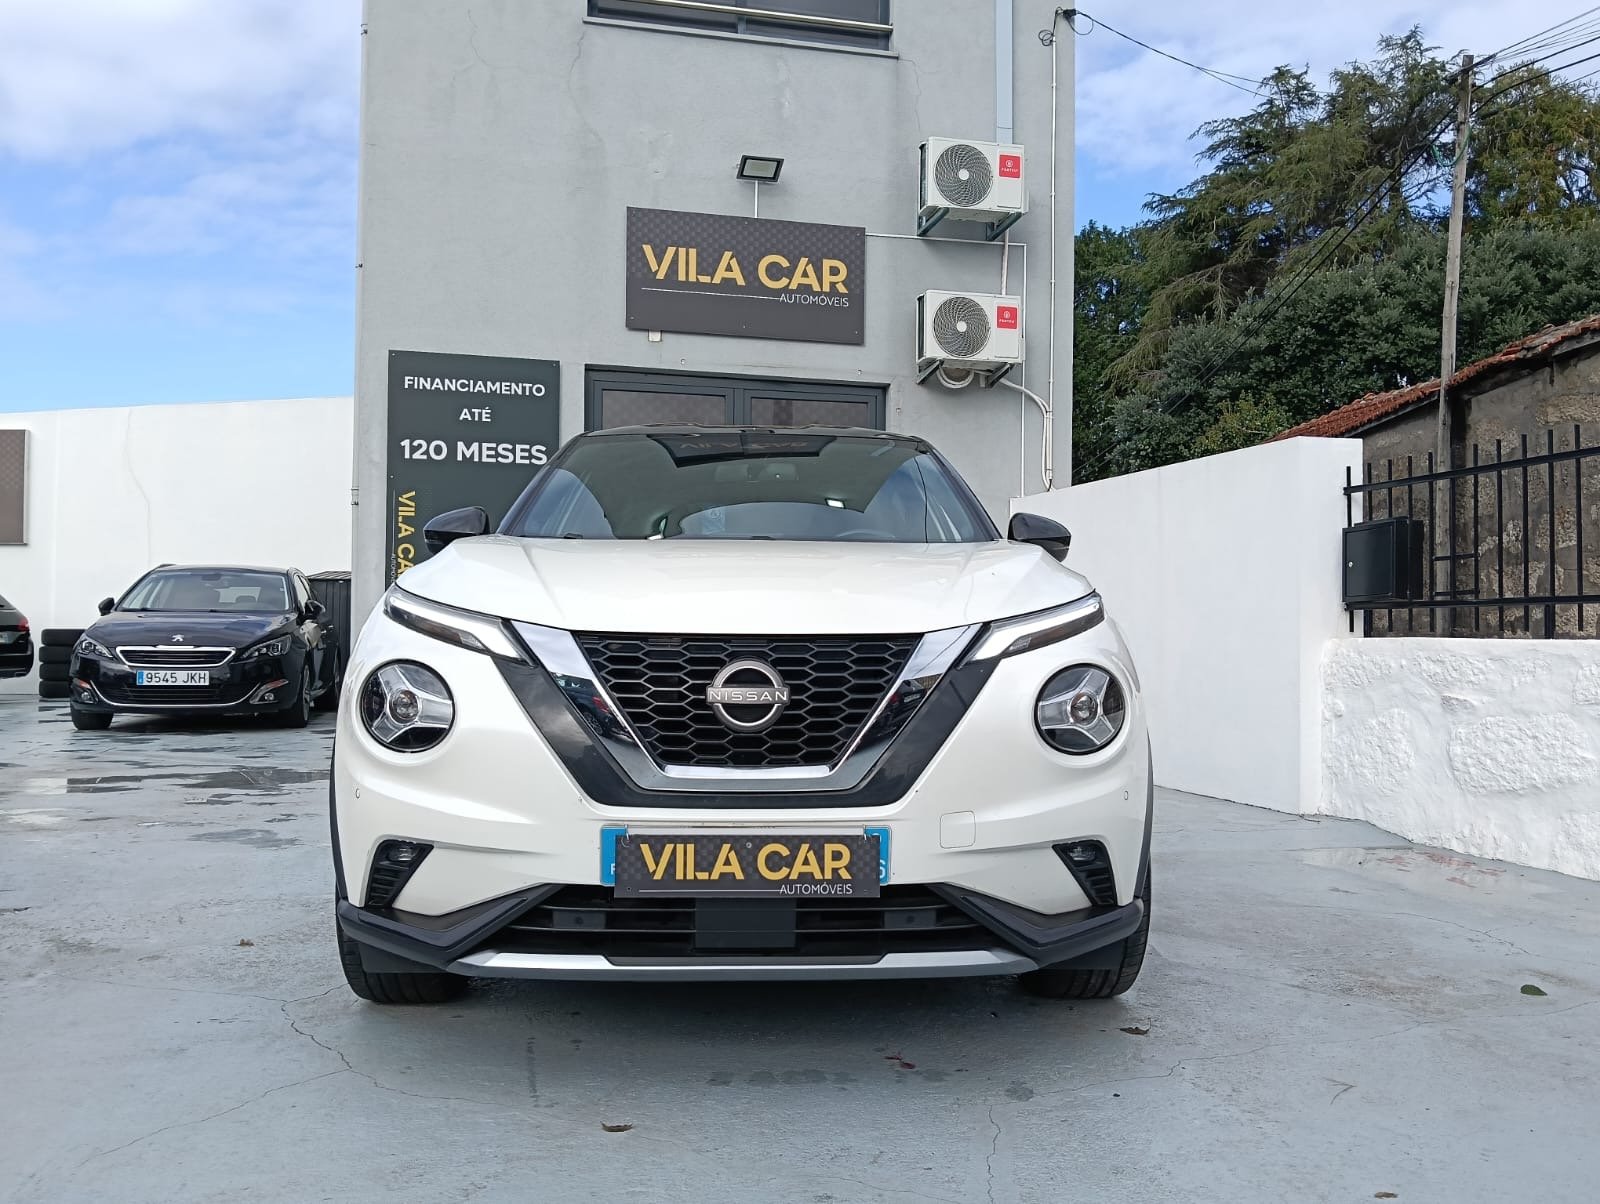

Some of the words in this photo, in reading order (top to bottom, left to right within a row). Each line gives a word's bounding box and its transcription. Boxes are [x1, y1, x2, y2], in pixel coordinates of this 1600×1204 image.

[642, 244, 746, 286] VILA
[757, 254, 849, 294] CAR
[779, 293, 849, 307] AUTOMÓVEIS
[403, 376, 546, 397] FINANCIAMENTO
[459, 406, 492, 422] ATÉ
[400, 438, 448, 460] 120
[456, 441, 548, 465] MESES
[398, 490, 416, 538] VILA
[397, 543, 415, 577] CA
[145, 672, 178, 684] 9545
[182, 671, 206, 684] JKH
[709, 691, 787, 701] NISSAN
[639, 843, 745, 881] VILA
[757, 843, 853, 881] CAR
[779, 882, 853, 895] AUTOMÓVEIS
